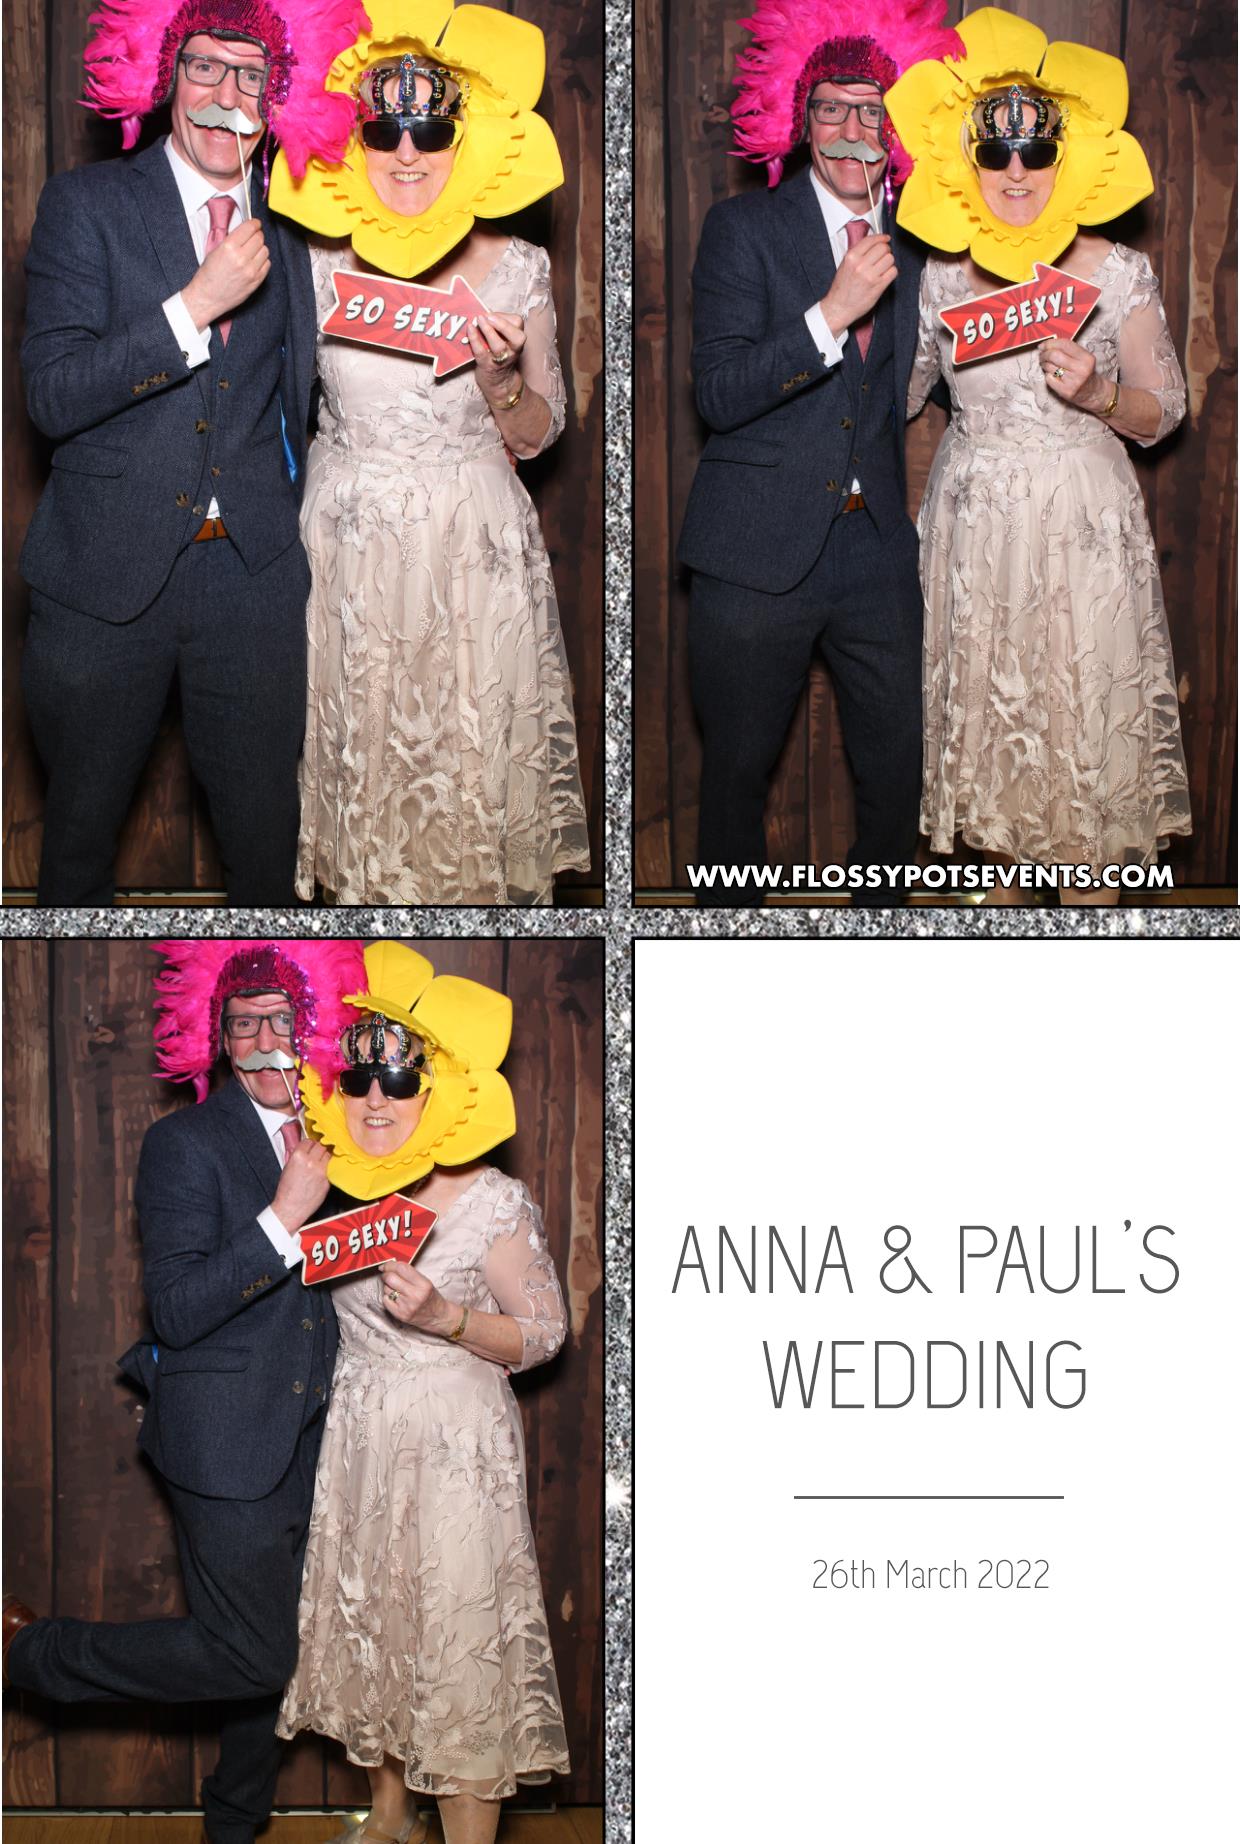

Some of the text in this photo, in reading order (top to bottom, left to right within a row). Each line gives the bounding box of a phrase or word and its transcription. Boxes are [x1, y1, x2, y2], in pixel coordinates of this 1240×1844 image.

[345, 294, 386, 325] SO
[963, 286, 1075, 345] SO SEXY!
[311, 1210, 413, 1267] SO SEXY!
